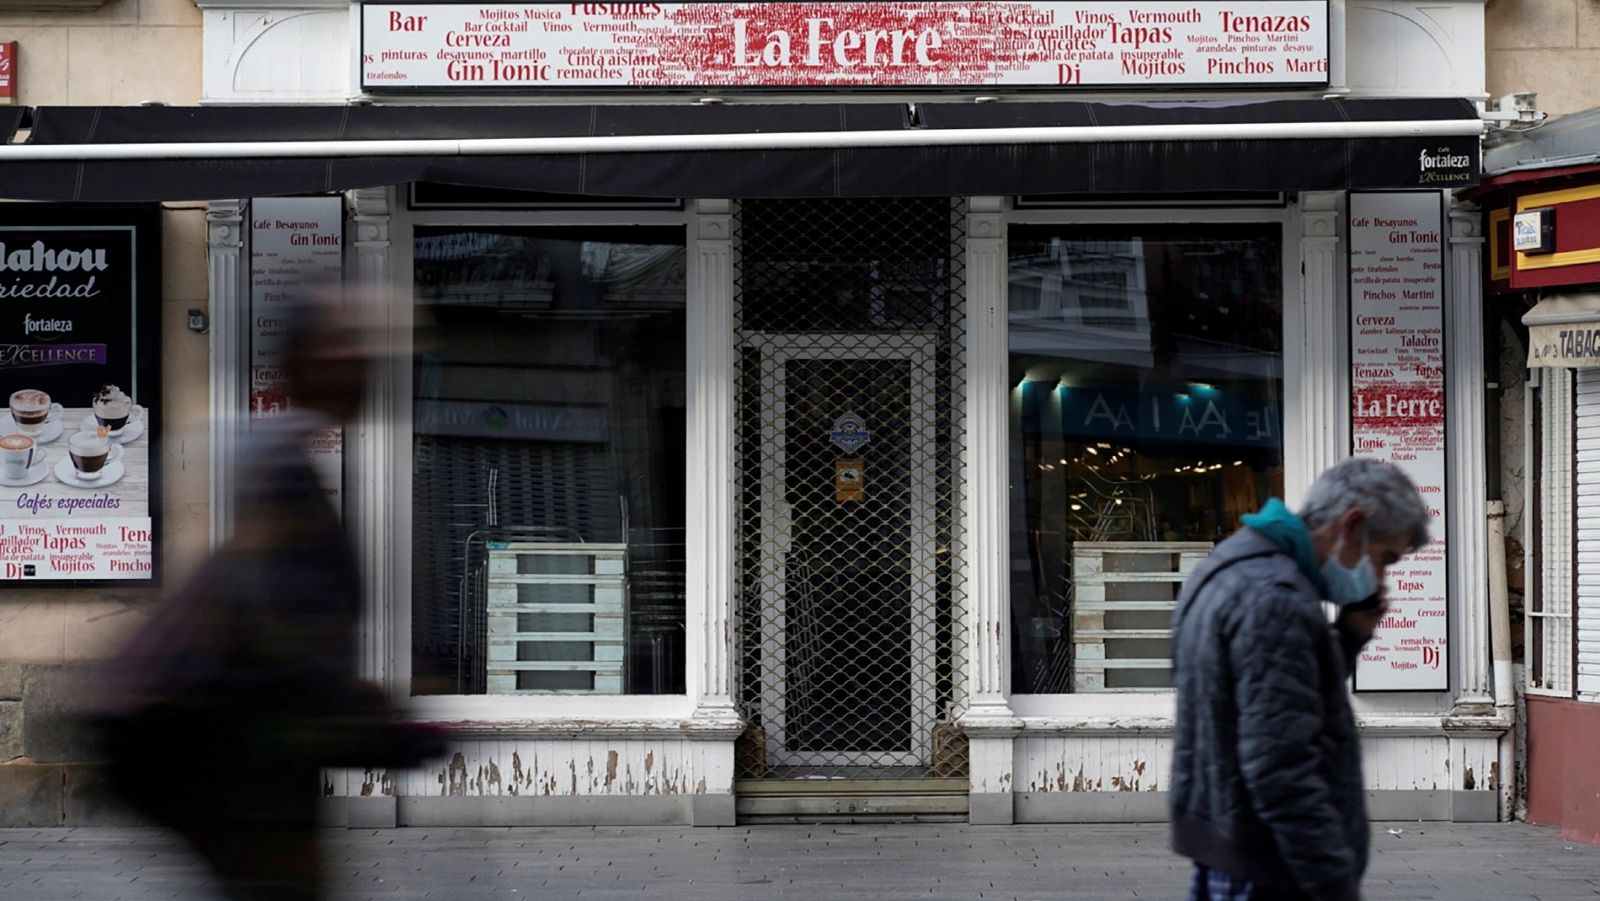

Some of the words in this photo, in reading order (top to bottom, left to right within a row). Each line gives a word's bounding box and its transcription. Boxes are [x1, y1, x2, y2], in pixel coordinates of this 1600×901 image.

[389, 10, 428, 32] Bar
[480, 9, 519, 22] Mojitos
[1075, 10, 1115, 24] Vinos
[1129, 8, 1201, 24] Vermouth
[1219, 11, 1310, 32] Tenazas
[464, 22, 483, 32] Bar
[485, 21, 528, 32] Cocktail
[543, 21, 573, 32] Vinos
[583, 21, 638, 32] Vermouth
[446, 31, 511, 47] Cerveza
[1107, 22, 1172, 49] Tapas
[1187, 35, 1218, 43] Mojitos
[1228, 34, 1260, 42] Pinchos
[1267, 34, 1298, 42] Martini
[731, 18, 792, 67] La
[1037, 36, 1096, 50] Alicates
[1196, 44, 1237, 53] arandelas
[1241, 45, 1277, 53] pinturas
[381, 49, 428, 62] pinturas
[437, 49, 494, 61] desayunos
[501, 49, 546, 60] martillo
[568, 53, 604, 66] Cinta
[1064, 49, 1076, 60] de
[1080, 50, 1113, 62] patata
[1120, 49, 1184, 62] insuperable
[447, 60, 484, 81] Gin
[489, 59, 551, 81] Tonic
[557, 66, 622, 80] remaches
[1122, 60, 1186, 79] Mojitos
[1208, 57, 1274, 75] Pinchos
[367, 71, 407, 80] tirafondos
[1419, 149, 1470, 172] fortaleza
[276, 220, 319, 232] Desayunos
[1374, 217, 1418, 229] Desayunos
[290, 233, 309, 246] Gin
[311, 232, 340, 246] Tonic
[1389, 231, 1407, 243] Gin
[1410, 230, 1440, 243] Tonic
[1363, 290, 1396, 300] Pinchos
[1402, 289, 1435, 299] Martini
[23, 313, 73, 335] fortaleza
[1356, 314, 1395, 325] Cerveza
[1401, 335, 1439, 347] Taladro
[1354, 367, 1394, 378] Tenazas
[1357, 394, 1382, 417] La
[17, 493, 52, 515] Cafés
[57, 493, 120, 515] especiales
[19, 525, 46, 535] Vinos
[56, 524, 106, 535] Vermouth
[41, 533, 86, 553] Tapas
[51, 560, 96, 574] Mojitos
[1397, 580, 1424, 593] Tapas
[1418, 608, 1445, 617] Cerveza
[1423, 646, 1439, 669] Dj
[1391, 661, 1418, 671] Mojitos
